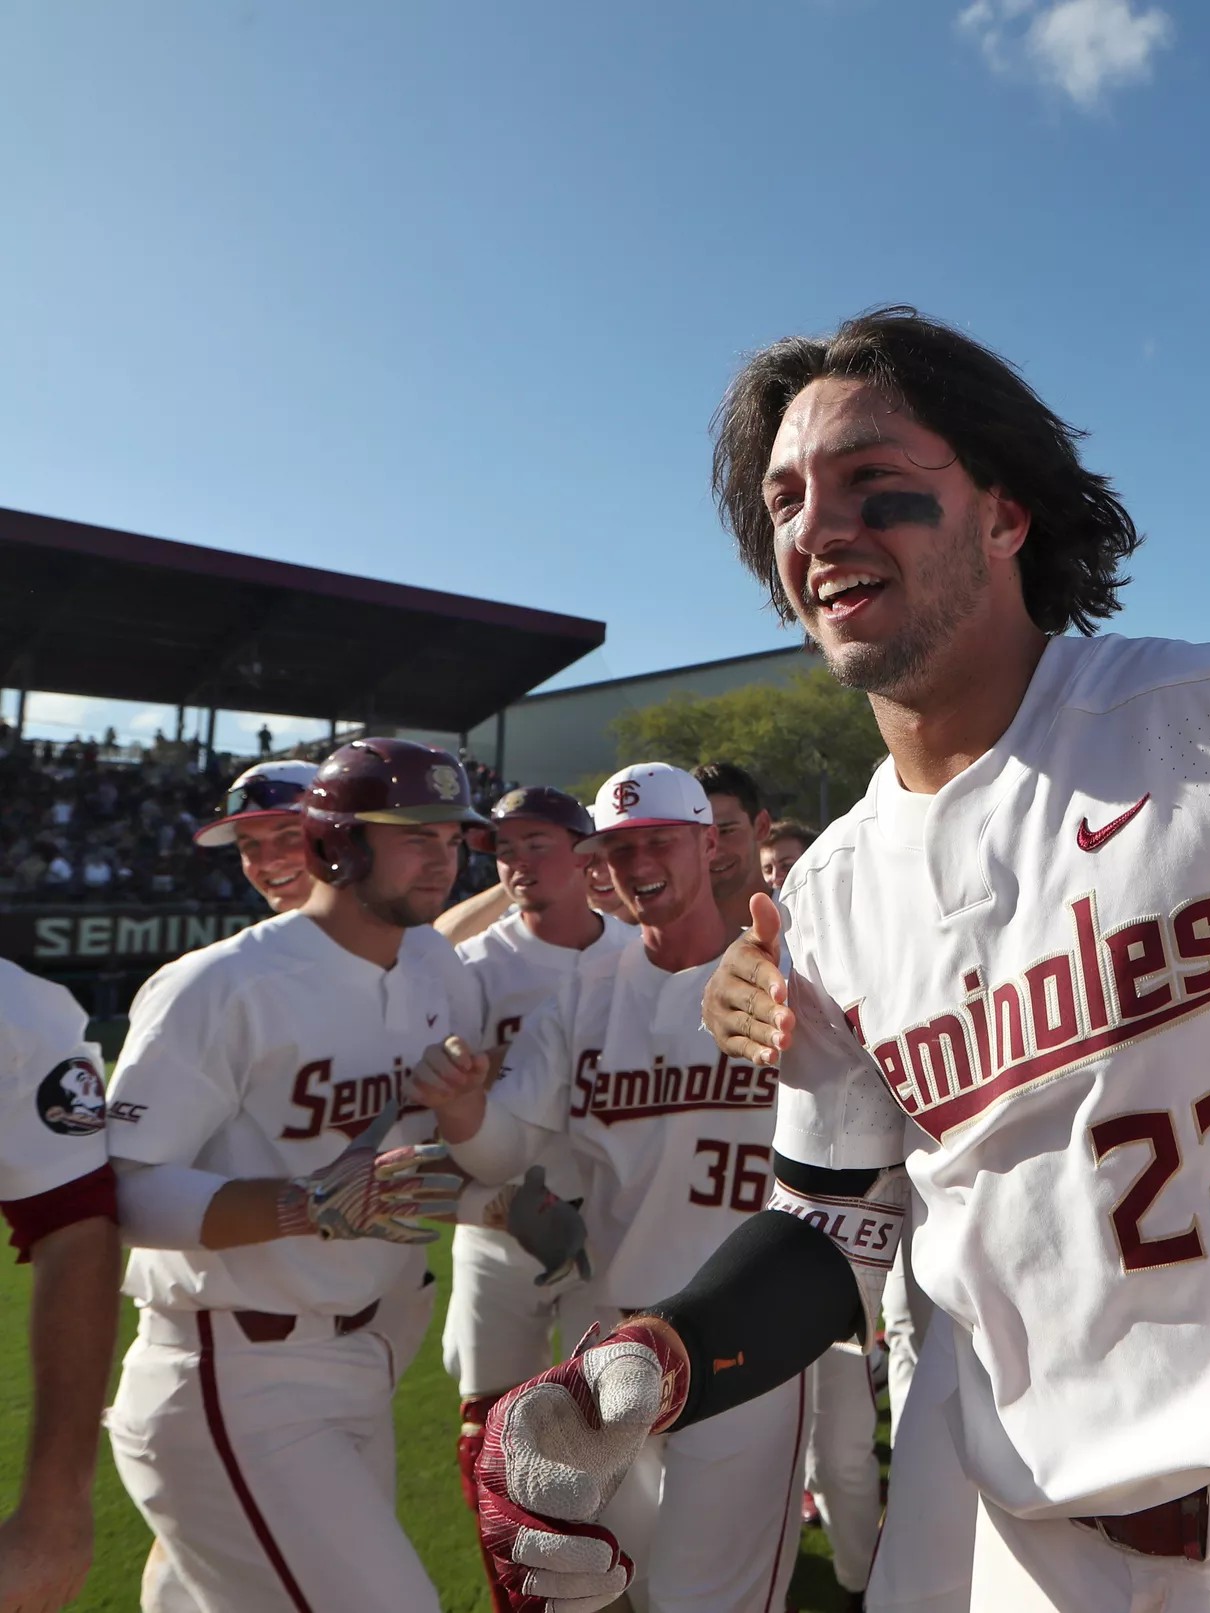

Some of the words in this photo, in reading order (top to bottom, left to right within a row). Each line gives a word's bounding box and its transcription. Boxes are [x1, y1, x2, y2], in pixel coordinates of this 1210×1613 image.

[279, 1056, 411, 1139] Semi
[570, 1047, 780, 1118] Seminoles
[689, 1139, 771, 1212] 36
[782, 1200, 894, 1250] OLES
